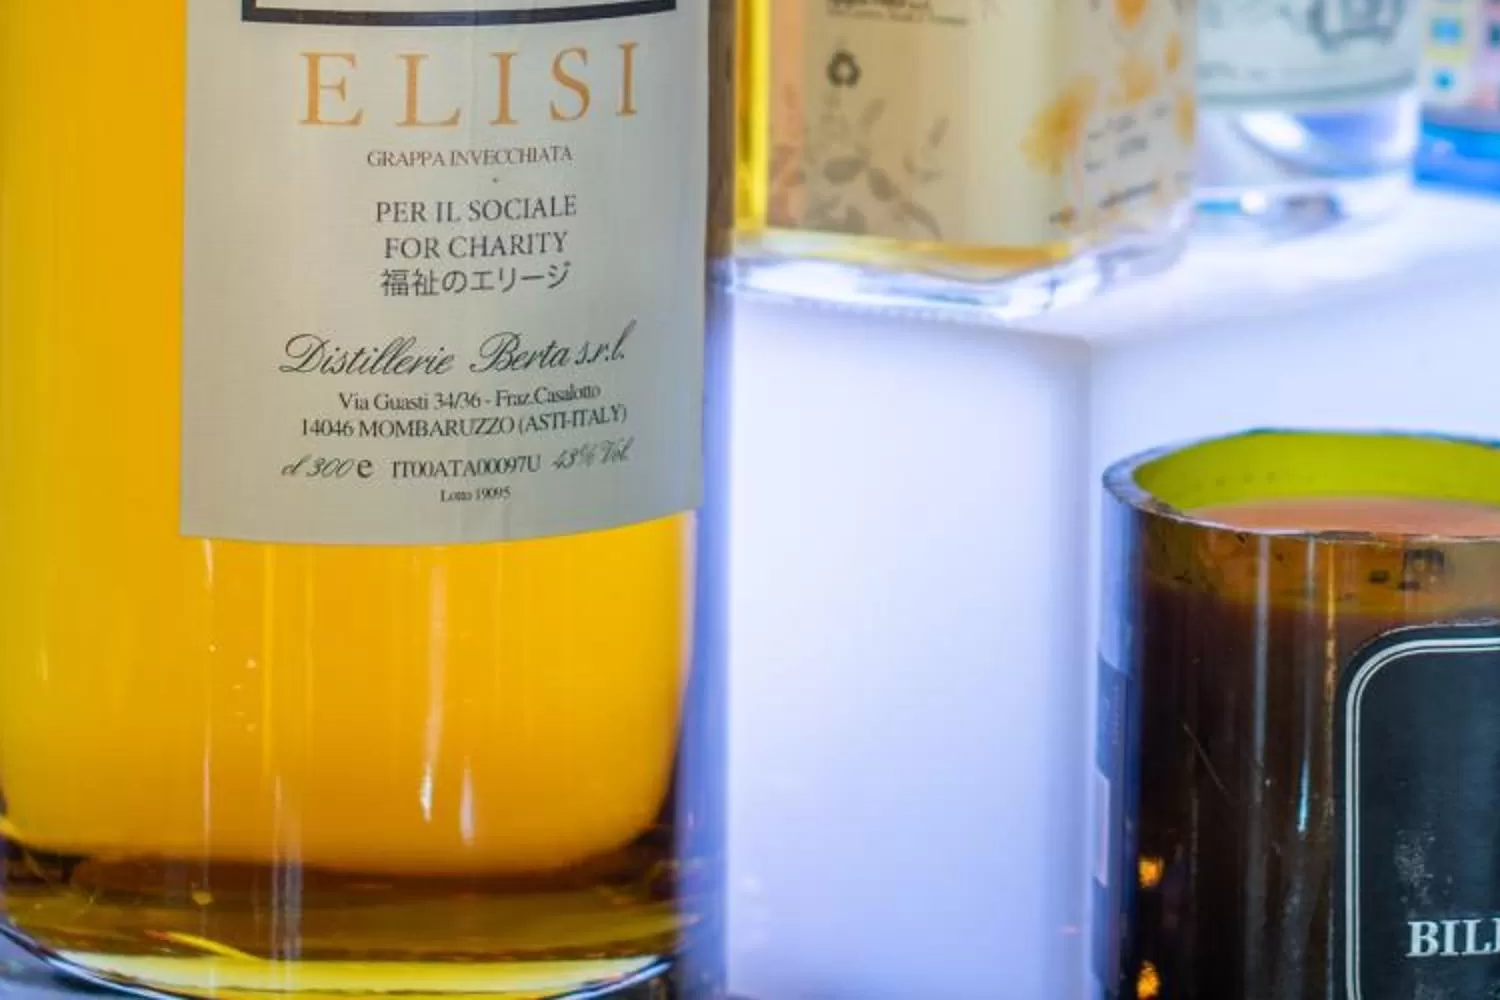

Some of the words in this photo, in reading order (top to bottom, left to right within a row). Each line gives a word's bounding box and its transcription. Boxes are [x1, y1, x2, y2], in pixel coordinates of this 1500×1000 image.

[297, 41, 640, 128] ELISI
[367, 150, 446, 168] GRAPPA
[450, 145, 573, 167] INVECCHIATA
[376, 200, 427, 223] PER
[436, 200, 462, 223] IL
[468, 194, 577, 222] SOCIALE
[384, 236, 441, 260] FOR
[449, 231, 568, 259] CHARITY
[380, 261, 572, 297] 福祉のエリージ
[279, 333, 456, 375] Distillerie
[469, 331, 571, 373] Berta
[338, 391, 369, 411] Via
[373, 391, 429, 411] Guasti
[433, 391, 481, 411] 34/36
[302, 418, 354, 437] 14046
[358, 416, 515, 438] MOMBARUZZO
[518, 403, 628, 436] (ASTI-ITALY)
